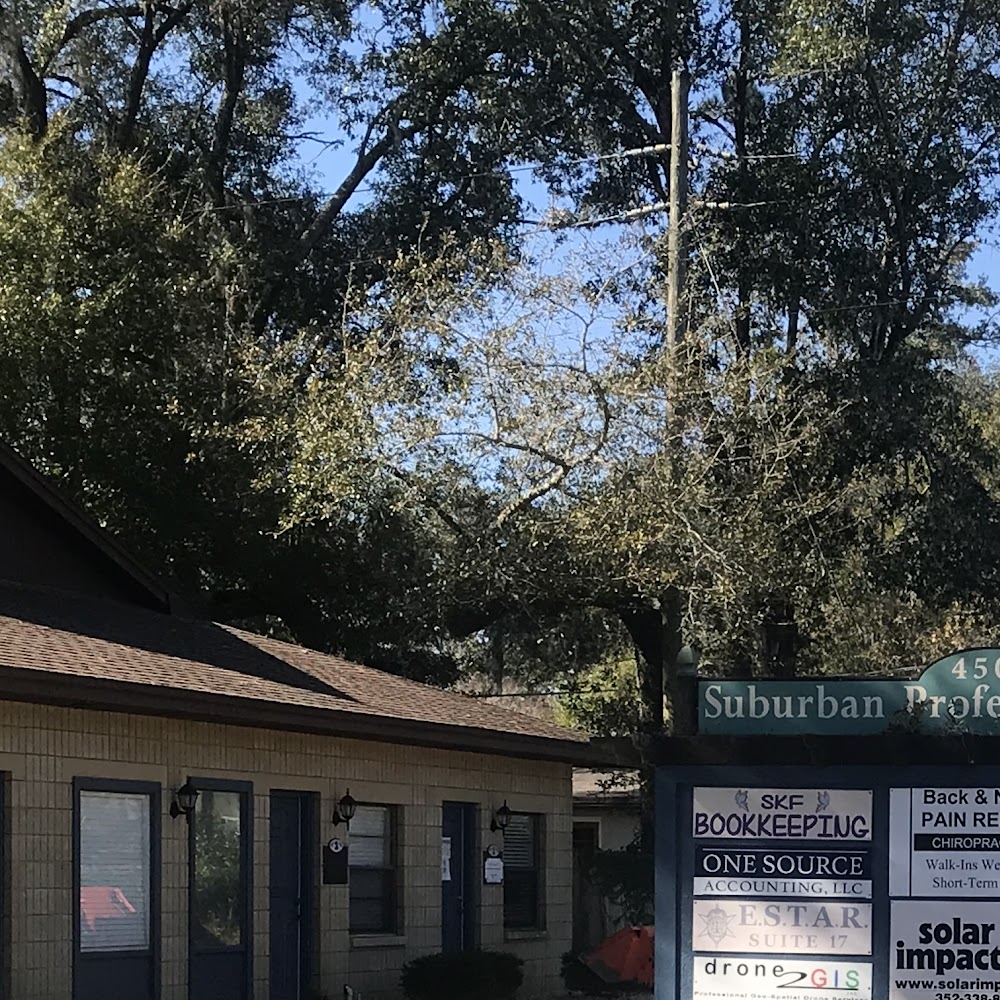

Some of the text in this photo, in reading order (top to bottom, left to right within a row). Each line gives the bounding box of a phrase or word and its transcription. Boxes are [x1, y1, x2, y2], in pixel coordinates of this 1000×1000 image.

[704, 684, 884, 719] Suburban
[761, 795, 804, 810] SKF
[923, 789, 969, 805] Back
[975, 789, 988, 805] &
[695, 813, 869, 838] BOOKKEEPING
[922, 812, 966, 827] PAIN
[703, 854, 863, 875] ONE SOURCE
[926, 859, 978, 871] Walk-Ins
[704, 881, 863, 894] ACCOUNTING, LLC
[932, 877, 998, 889] Short-Term
[738, 904, 868, 928] E.S.T.A.R.
[919, 917, 995, 945] solar
[749, 934, 848, 948] SUITE 17
